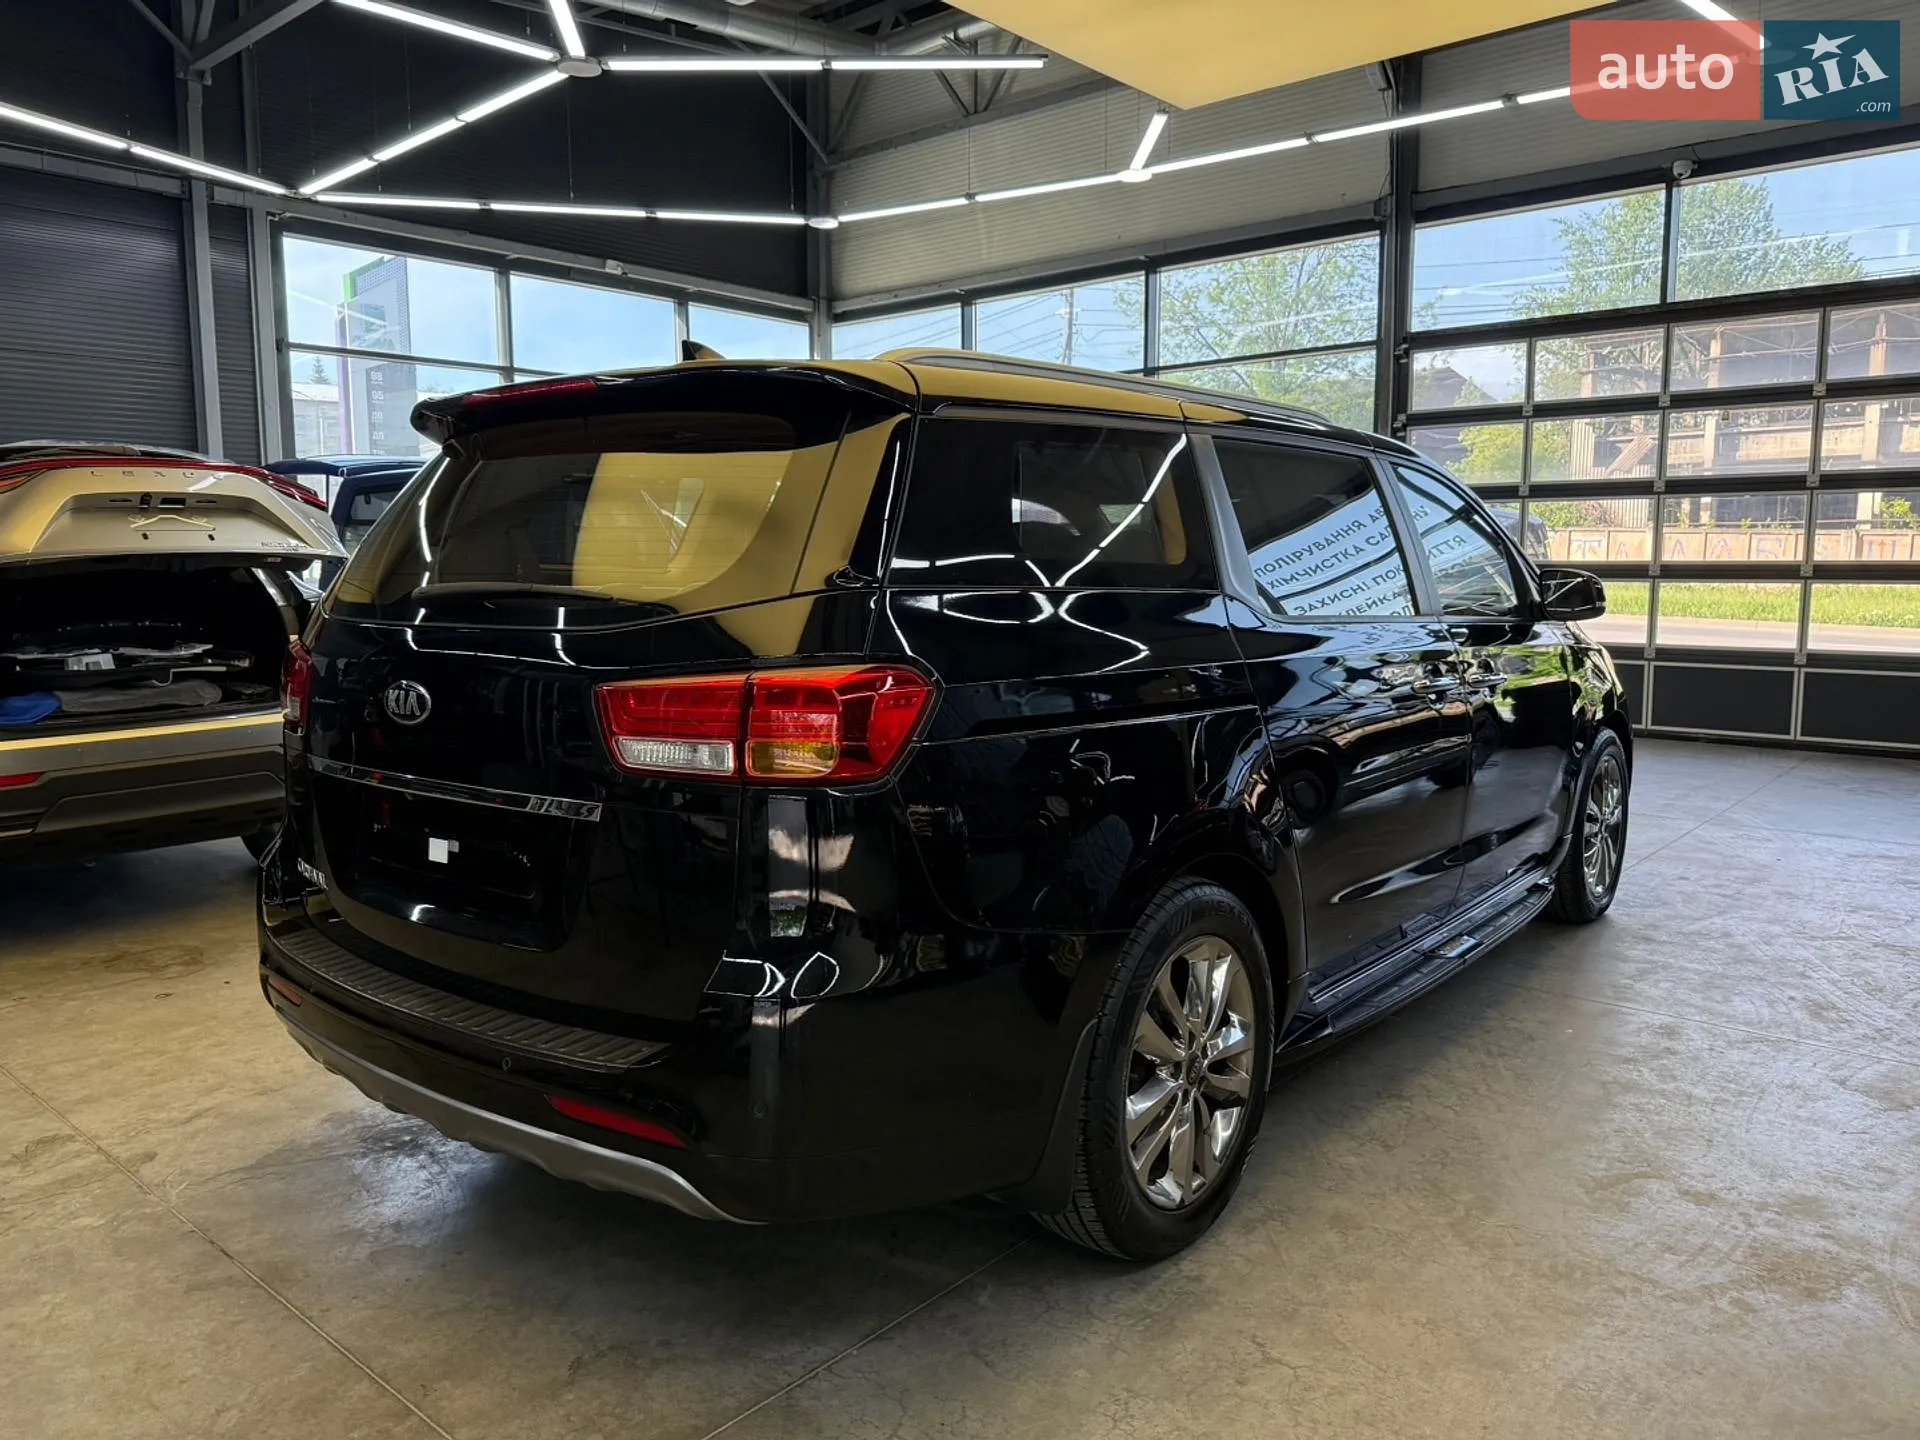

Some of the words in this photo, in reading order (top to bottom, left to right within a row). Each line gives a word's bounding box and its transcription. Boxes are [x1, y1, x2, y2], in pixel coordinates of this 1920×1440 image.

[1254, 519, 1367, 578] ПОЛІРУВАННЯ
[1368, 505, 1386, 523] АВ
[1266, 545, 1366, 590] ХІМЧИСТКА
[1293, 581, 1370, 615] ЗАХИСНІ
[388, 689, 420, 716] KIA
